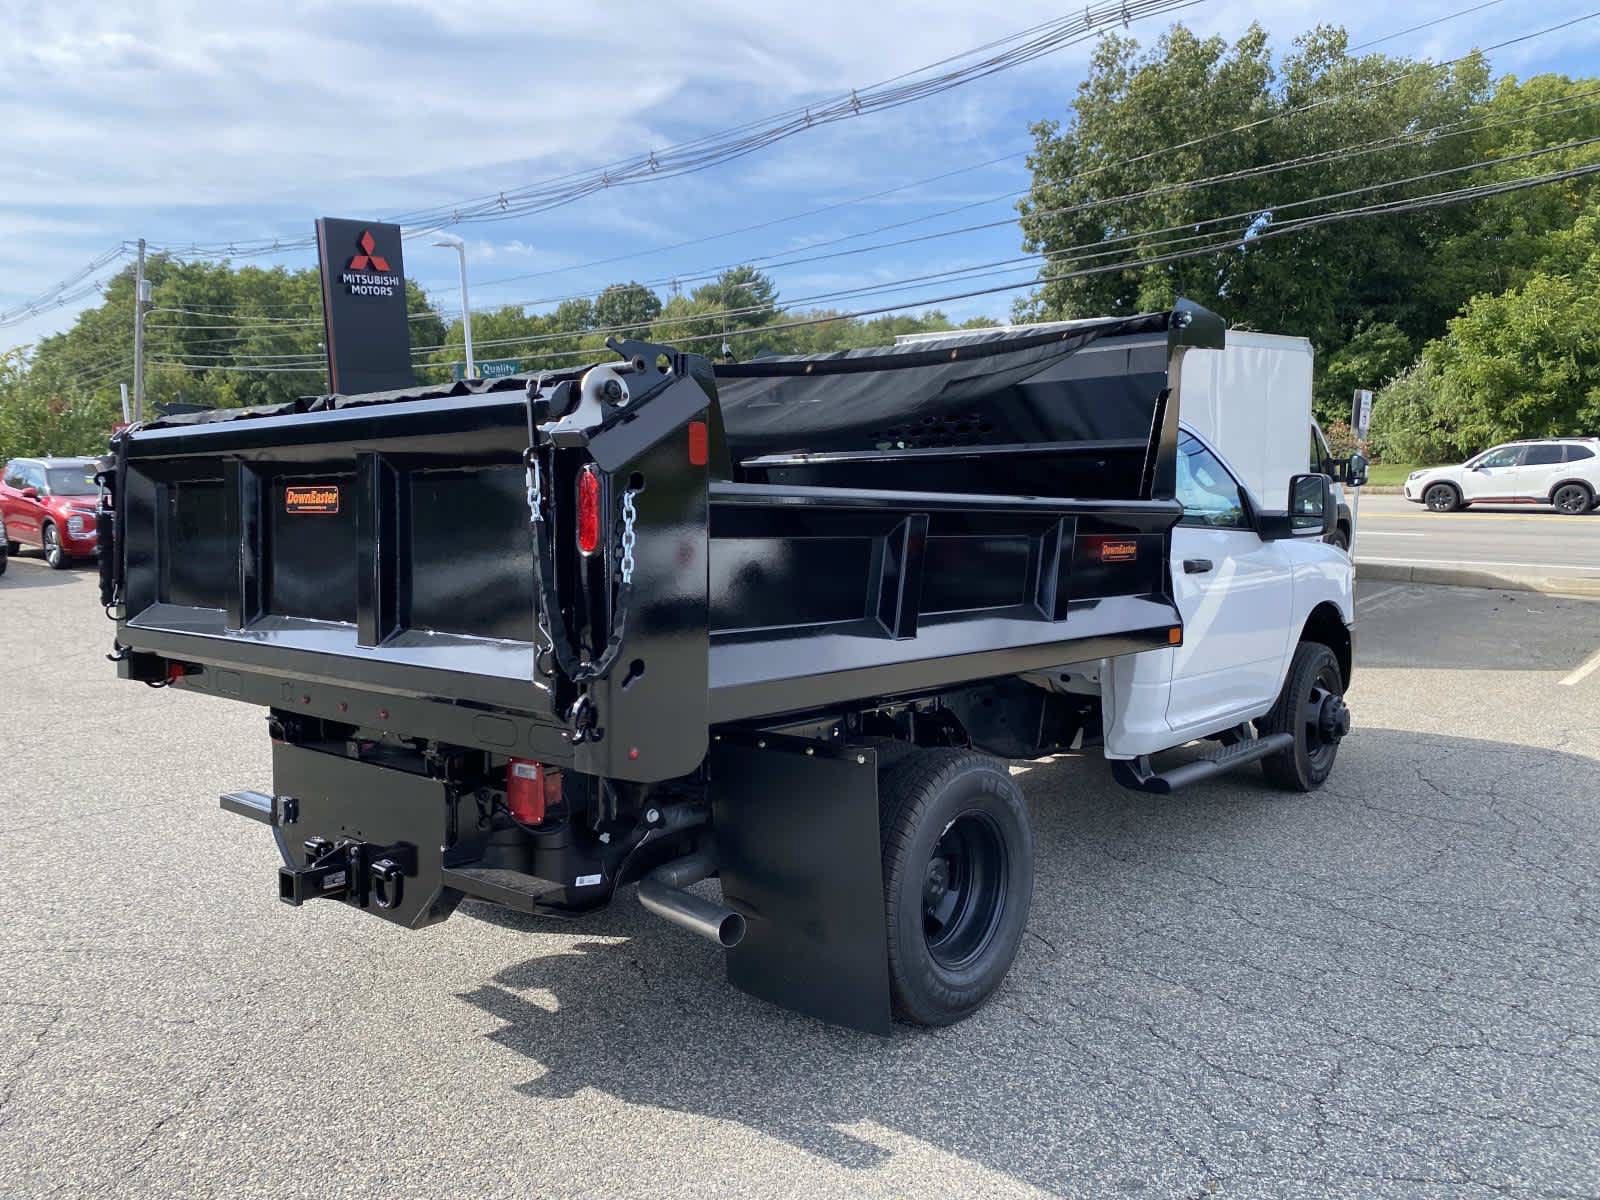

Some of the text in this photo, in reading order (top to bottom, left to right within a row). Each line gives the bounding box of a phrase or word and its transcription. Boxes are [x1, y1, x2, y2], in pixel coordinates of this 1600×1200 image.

[342, 273, 399, 286] MITSUBISHI
[351, 284, 393, 297] MOTORS
[482, 362, 515, 376] Quality
[287, 490, 337, 504] DownEaster
